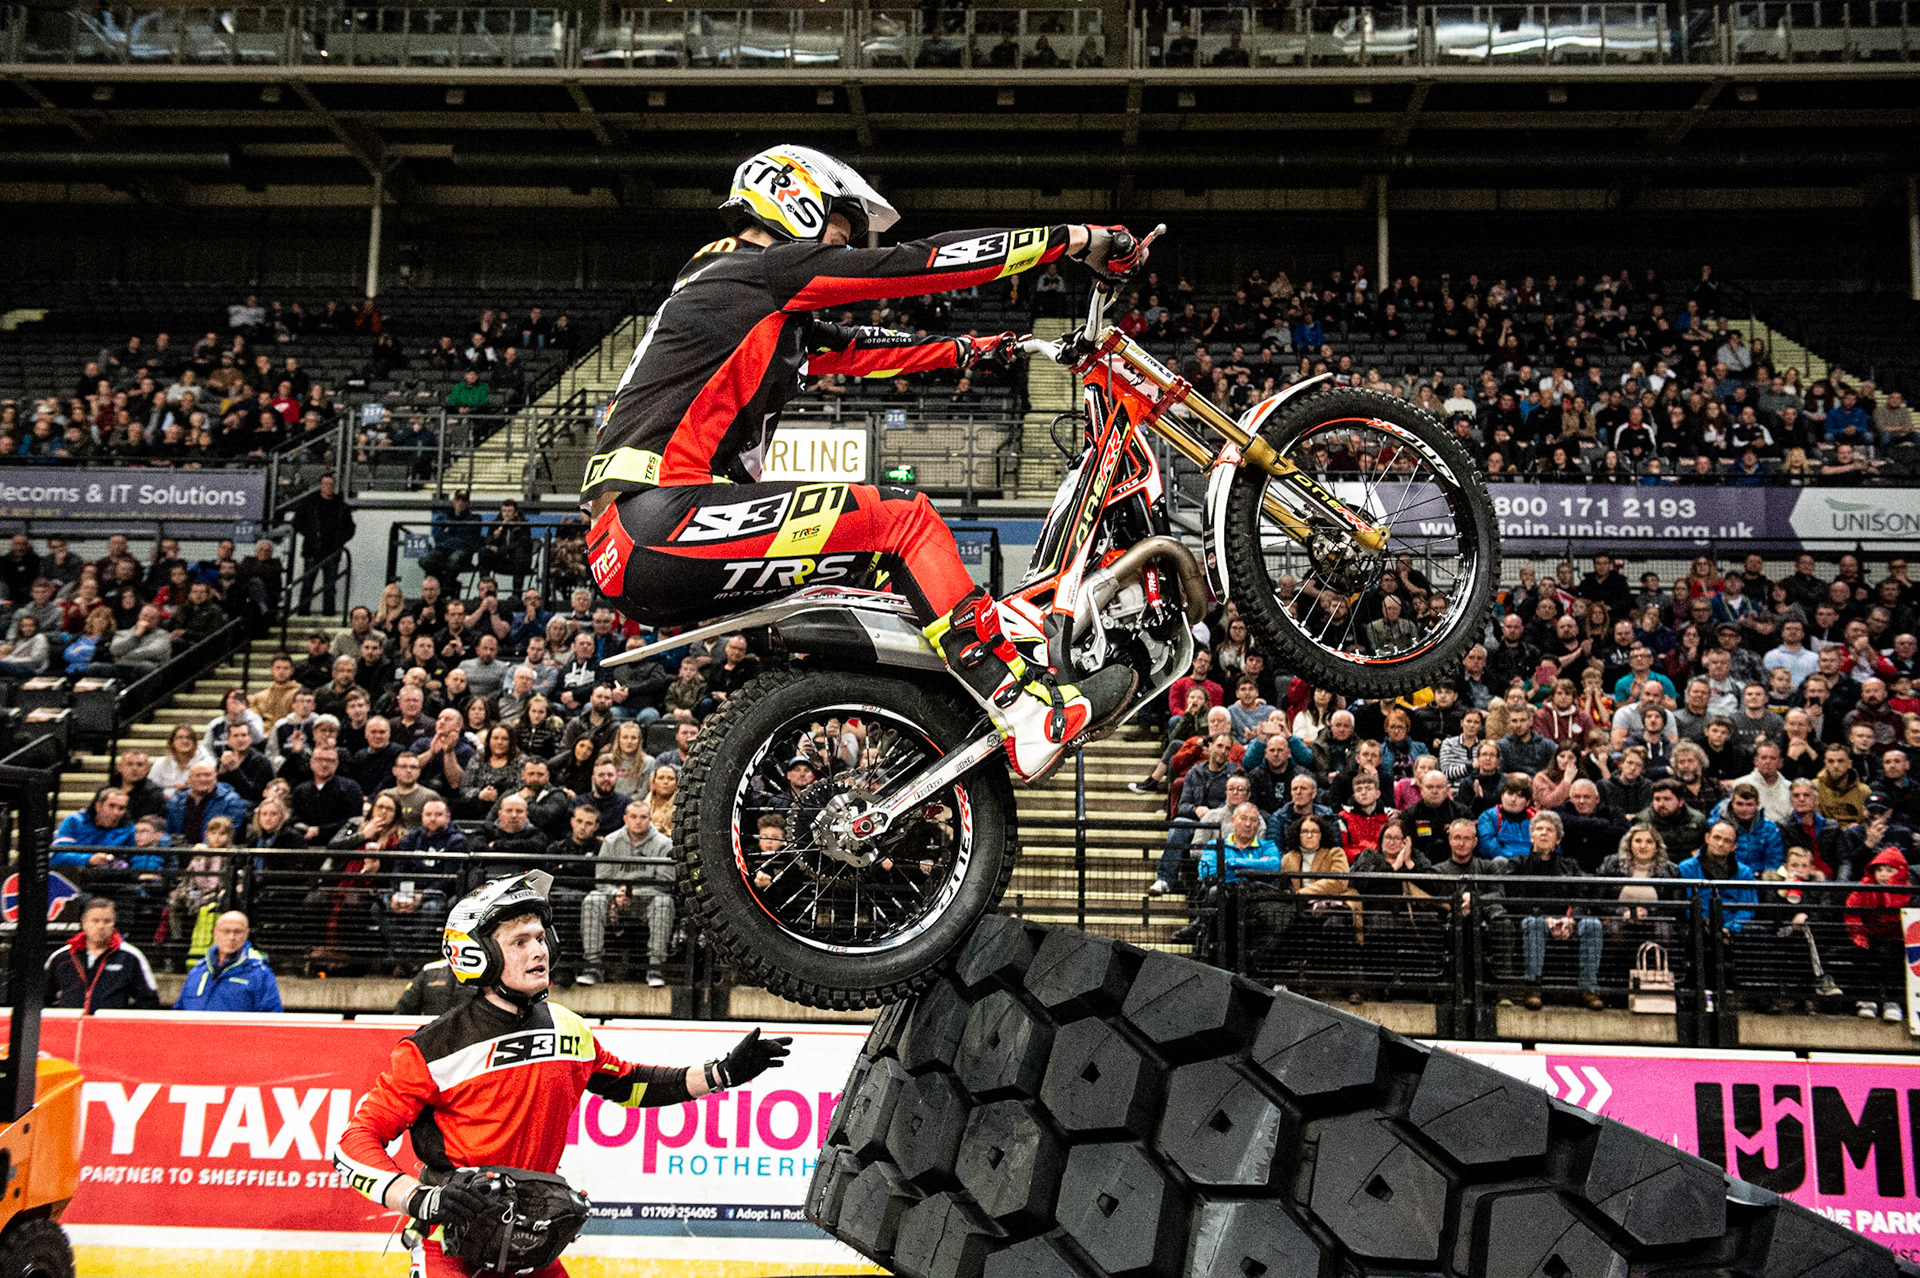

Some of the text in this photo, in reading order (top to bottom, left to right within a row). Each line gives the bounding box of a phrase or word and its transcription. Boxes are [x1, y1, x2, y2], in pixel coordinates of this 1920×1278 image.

[763, 440, 859, 473] RLING
[86, 484, 101, 502] &
[111, 484, 132, 503] IT
[139, 485, 246, 506] Solutions
[1560, 498, 1609, 517] 171
[1623, 498, 1696, 518] 2193
[960, 545, 981, 555] 116
[80, 1165, 164, 1185] PARTNER
[168, 1167, 193, 1185] TO
[198, 1168, 301, 1188] SHEFFIELD
[640, 1207, 675, 1218] 01709
[676, 1208, 718, 1220] 254005
[736, 1208, 768, 1222] Adopt
[770, 1209, 781, 1220] in
